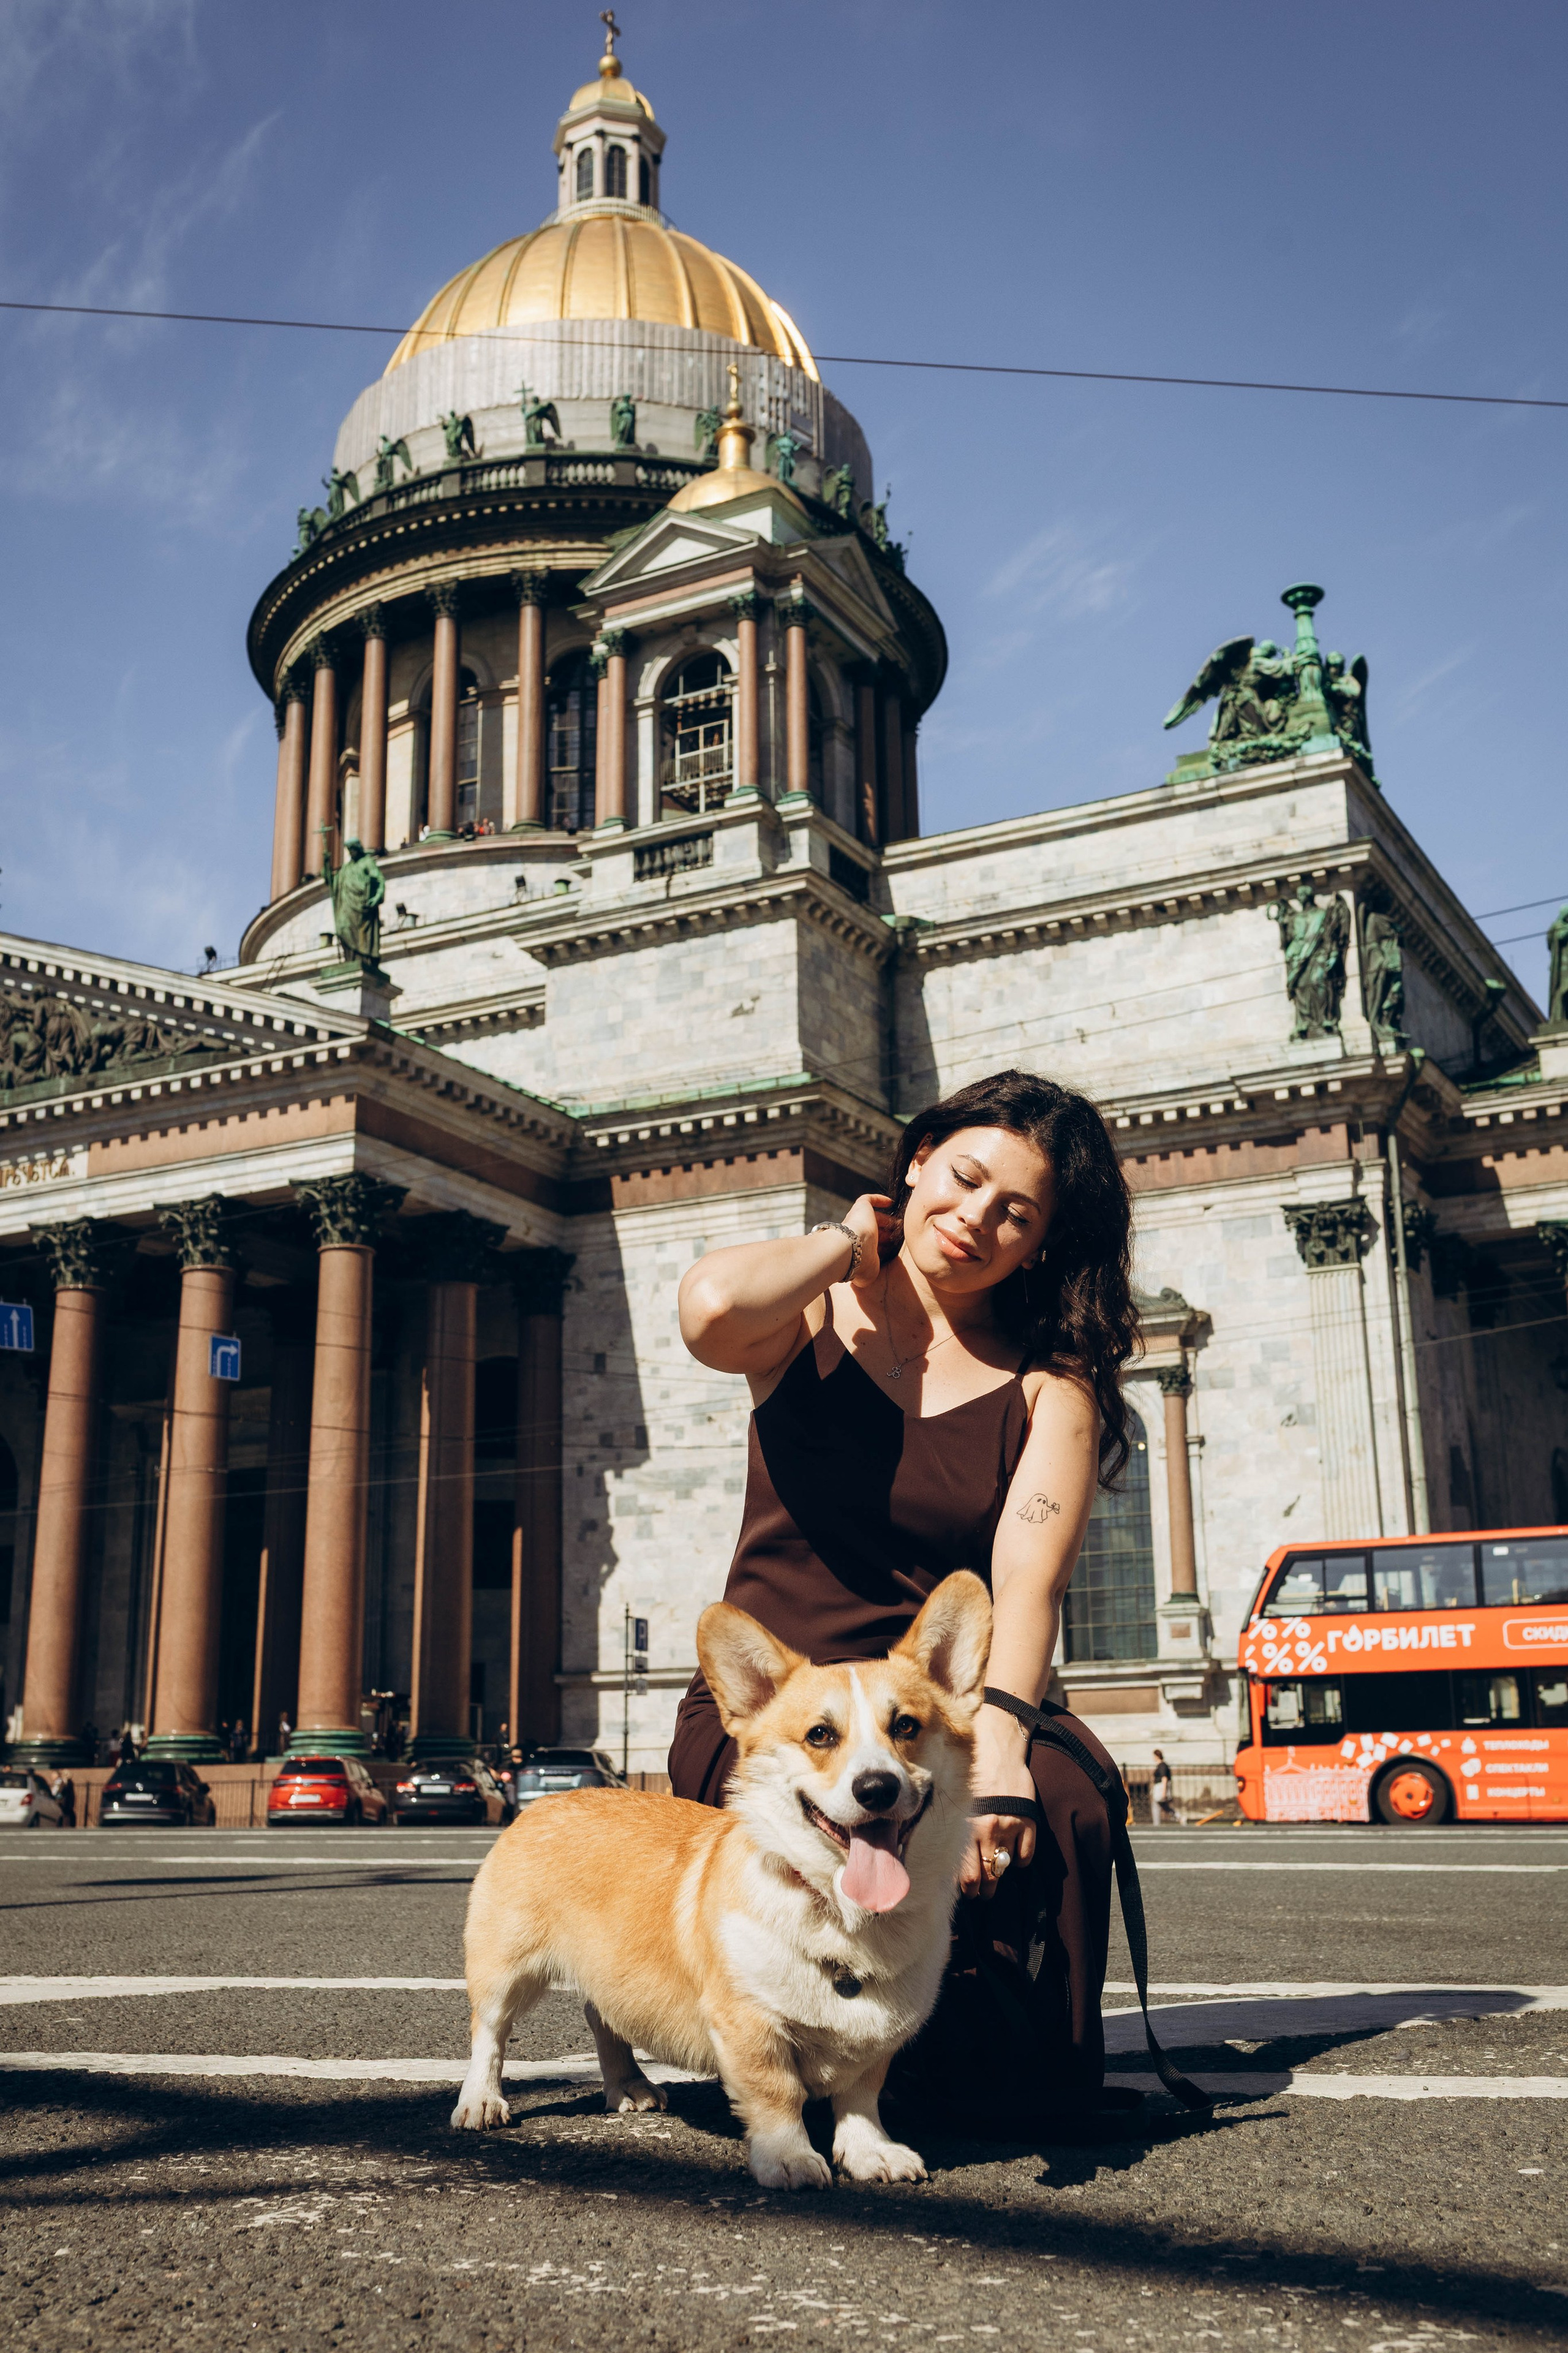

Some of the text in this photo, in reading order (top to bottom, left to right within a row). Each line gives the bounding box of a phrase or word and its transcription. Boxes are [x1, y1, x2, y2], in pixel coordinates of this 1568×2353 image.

[1327, 1623, 1476, 1653] ГОРБИЛЕТ
[1483, 1739, 1550, 1751] ТЕПЛОХОДЫ
[1485, 1762, 1549, 1773] СПЕКТАКЛИ
[1487, 1786, 1546, 1799] КОНЦЕРТЫ
